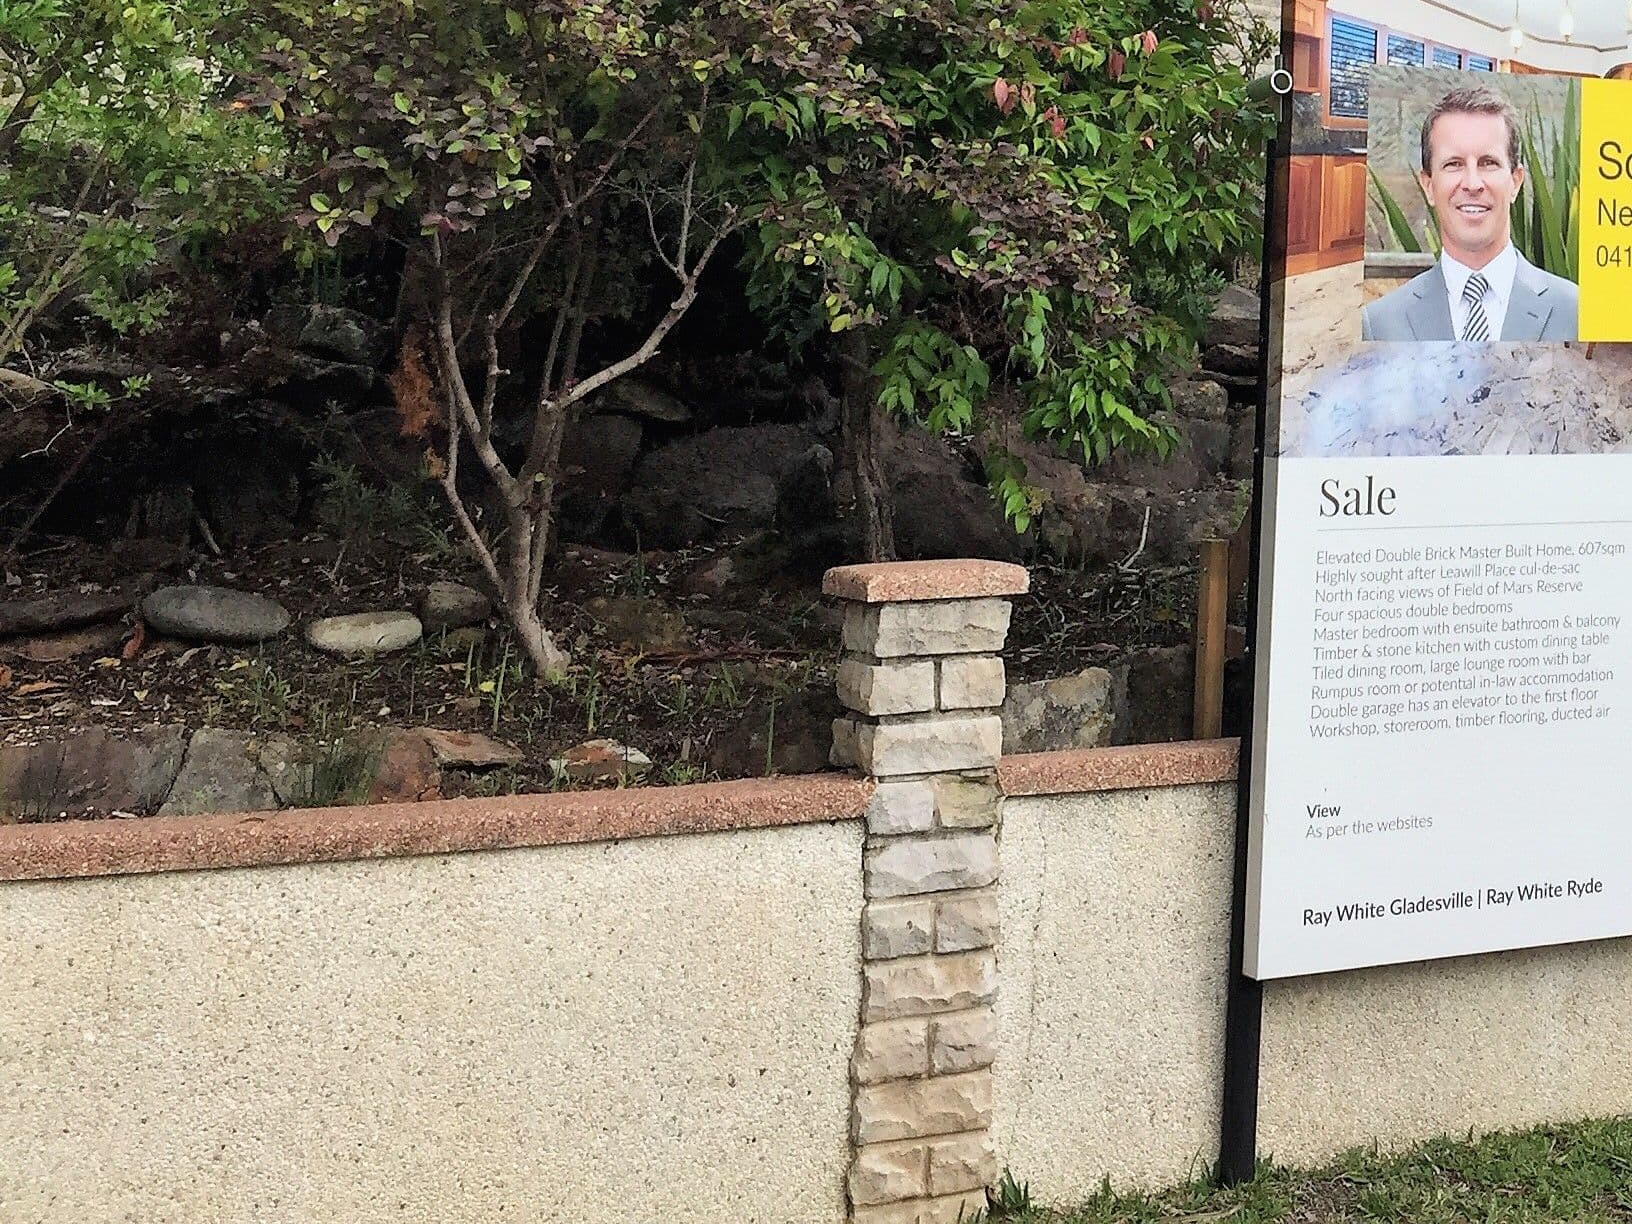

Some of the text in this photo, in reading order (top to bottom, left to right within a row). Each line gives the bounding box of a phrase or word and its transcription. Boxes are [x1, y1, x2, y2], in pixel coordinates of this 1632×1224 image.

[1319, 476, 1396, 518] Sale
[1316, 549, 1371, 565] Elevated
[1376, 548, 1421, 563] Double
[1425, 546, 1455, 560] Brick
[1459, 546, 1501, 559] Master
[1506, 544, 1532, 558] Built
[1579, 542, 1625, 556] 607sqm
[1316, 569, 1356, 587] Highly
[1361, 568, 1403, 584] sought
[1407, 565, 1436, 580] after
[1485, 563, 1515, 577] Place
[1315, 580, 1583, 603] North facing views of Field of Mars Reserve
[1314, 601, 1513, 622] Four spacious double bedrooms
[1313, 615, 1621, 641] Master bedroom with ensuite bathroom & balcony
[1313, 633, 1609, 661] Timber & stone kitchen with custom dining table
[1313, 652, 1591, 681] Tiled dining room, large lounge room with bar
[1311, 670, 1613, 704] Rumpus room or potential in-law accommodation
[1311, 688, 1599, 720] Double garage has an elevator to the first floor
[1310, 723, 1380, 740] Workshop,
[1455, 714, 1494, 729] timber
[1551, 707, 1592, 722] ducted
[1596, 705, 1610, 718] air
[1306, 804, 1341, 819] View
[1306, 815, 1433, 839] As per the websites
[1303, 908, 1333, 927] Ray
[1337, 902, 1385, 923] White
[1390, 892, 1473, 916] Gladesville
[1487, 888, 1514, 906] Ray
[1518, 882, 1563, 902] White
[1568, 878, 1603, 897] Ryde
